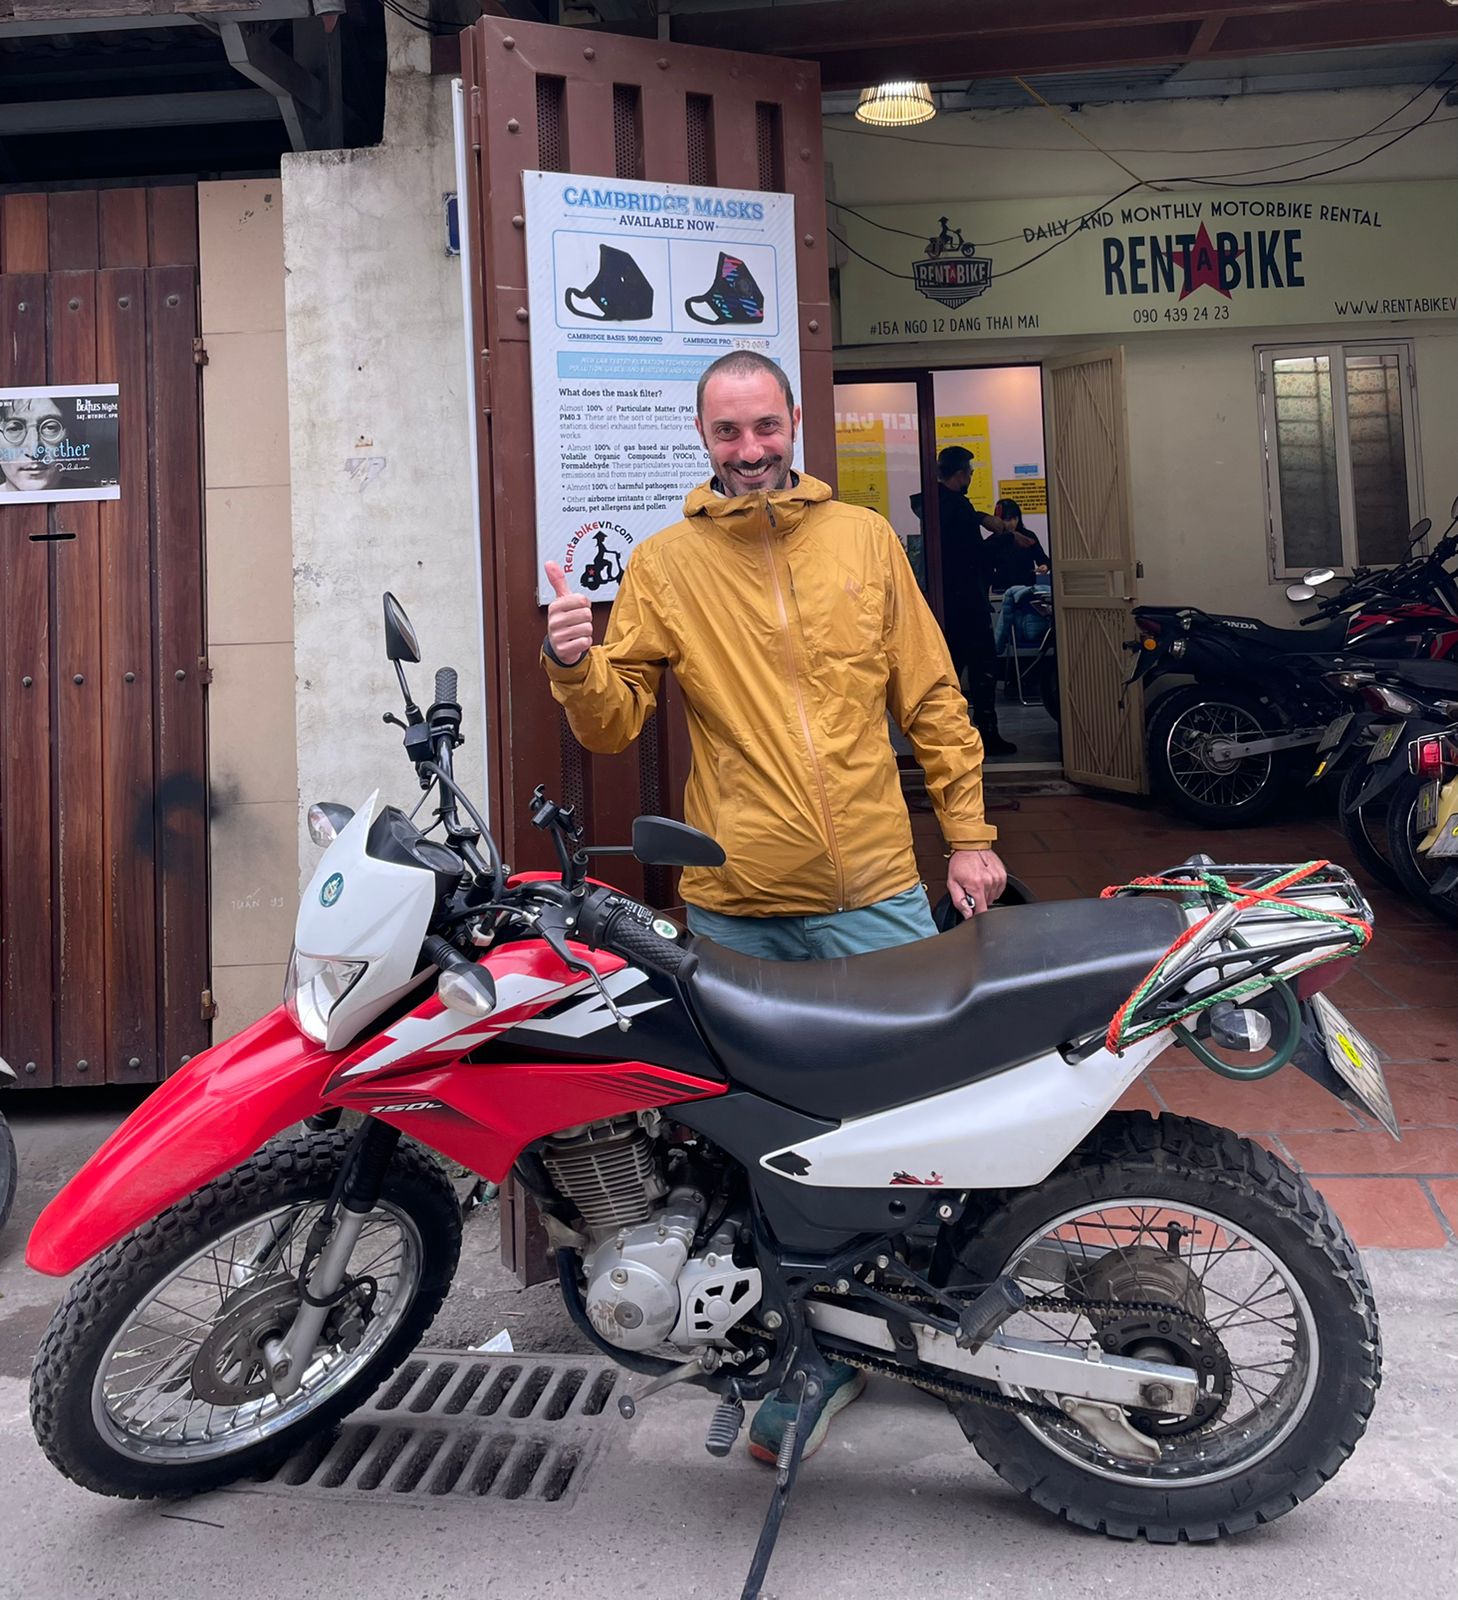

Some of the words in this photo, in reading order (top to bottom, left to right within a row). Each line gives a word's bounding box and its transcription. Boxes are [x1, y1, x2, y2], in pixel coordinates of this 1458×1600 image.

[563, 187, 690, 214] CAMBRIDGE
[693, 198, 765, 220] MASKS
[619, 215, 684, 230] AVAILABLE
[687, 220, 715, 231] NOW
[1023, 219, 1068, 243] DAILY
[1079, 212, 1114, 232] AND
[1121, 203, 1202, 224] MONTHLY
[1211, 201, 1312, 219] MOTORBIKE
[1320, 205, 1382, 227] RENTAL
[1133, 309, 1158, 324] 090
[1164, 307, 1187, 323] 439
[1193, 307, 1208, 321] 24
[1214, 306, 1230, 320] 23
[870, 321, 899, 336] #15A
[904, 320, 928, 334] NGO
[933, 318, 945, 332] 12
[951, 317, 981, 332] DANG
[986, 316, 1013, 330] THAI
[1018, 315, 1039, 328] MAI
[567, 333, 605, 341] CAMBRIDGE
[683, 337, 718, 345] CAMBRIDGE
[558, 388, 580, 397] What
[581, 388, 600, 397] does
[602, 389, 615, 397] the
[616, 389, 638, 397] mask
[639, 389, 663, 398] filter?
[559, 404, 583, 412] Almost
[606, 404, 613, 412] of
[678, 405, 694, 414] (PM)
[584, 413, 605, 421] These
[654, 414, 682, 423] particles
[589, 422, 609, 430] diesel
[660, 423, 682, 432] factory
[32, 438, 90, 464] together
[594, 453, 620, 461] Organic
[627, 453, 666, 461] Compounds
[633, 462, 671, 470] particulates
[561, 471, 596, 479] emissions
[628, 472, 646, 480] many
[645, 482, 678, 491] pathogens
[566, 495, 586, 503] Other
[587, 495, 615, 503] airborne
[617, 494, 644, 502] irritants
[653, 493, 683, 502] allergens
[562, 505, 587, 513] odours,
[588, 505, 600, 513] pet
[601, 504, 632, 512] allergens
[632, 503, 645, 511] and
[645, 502, 667, 512] pollen
[563, 520, 634, 574] Rentabikevn.com
